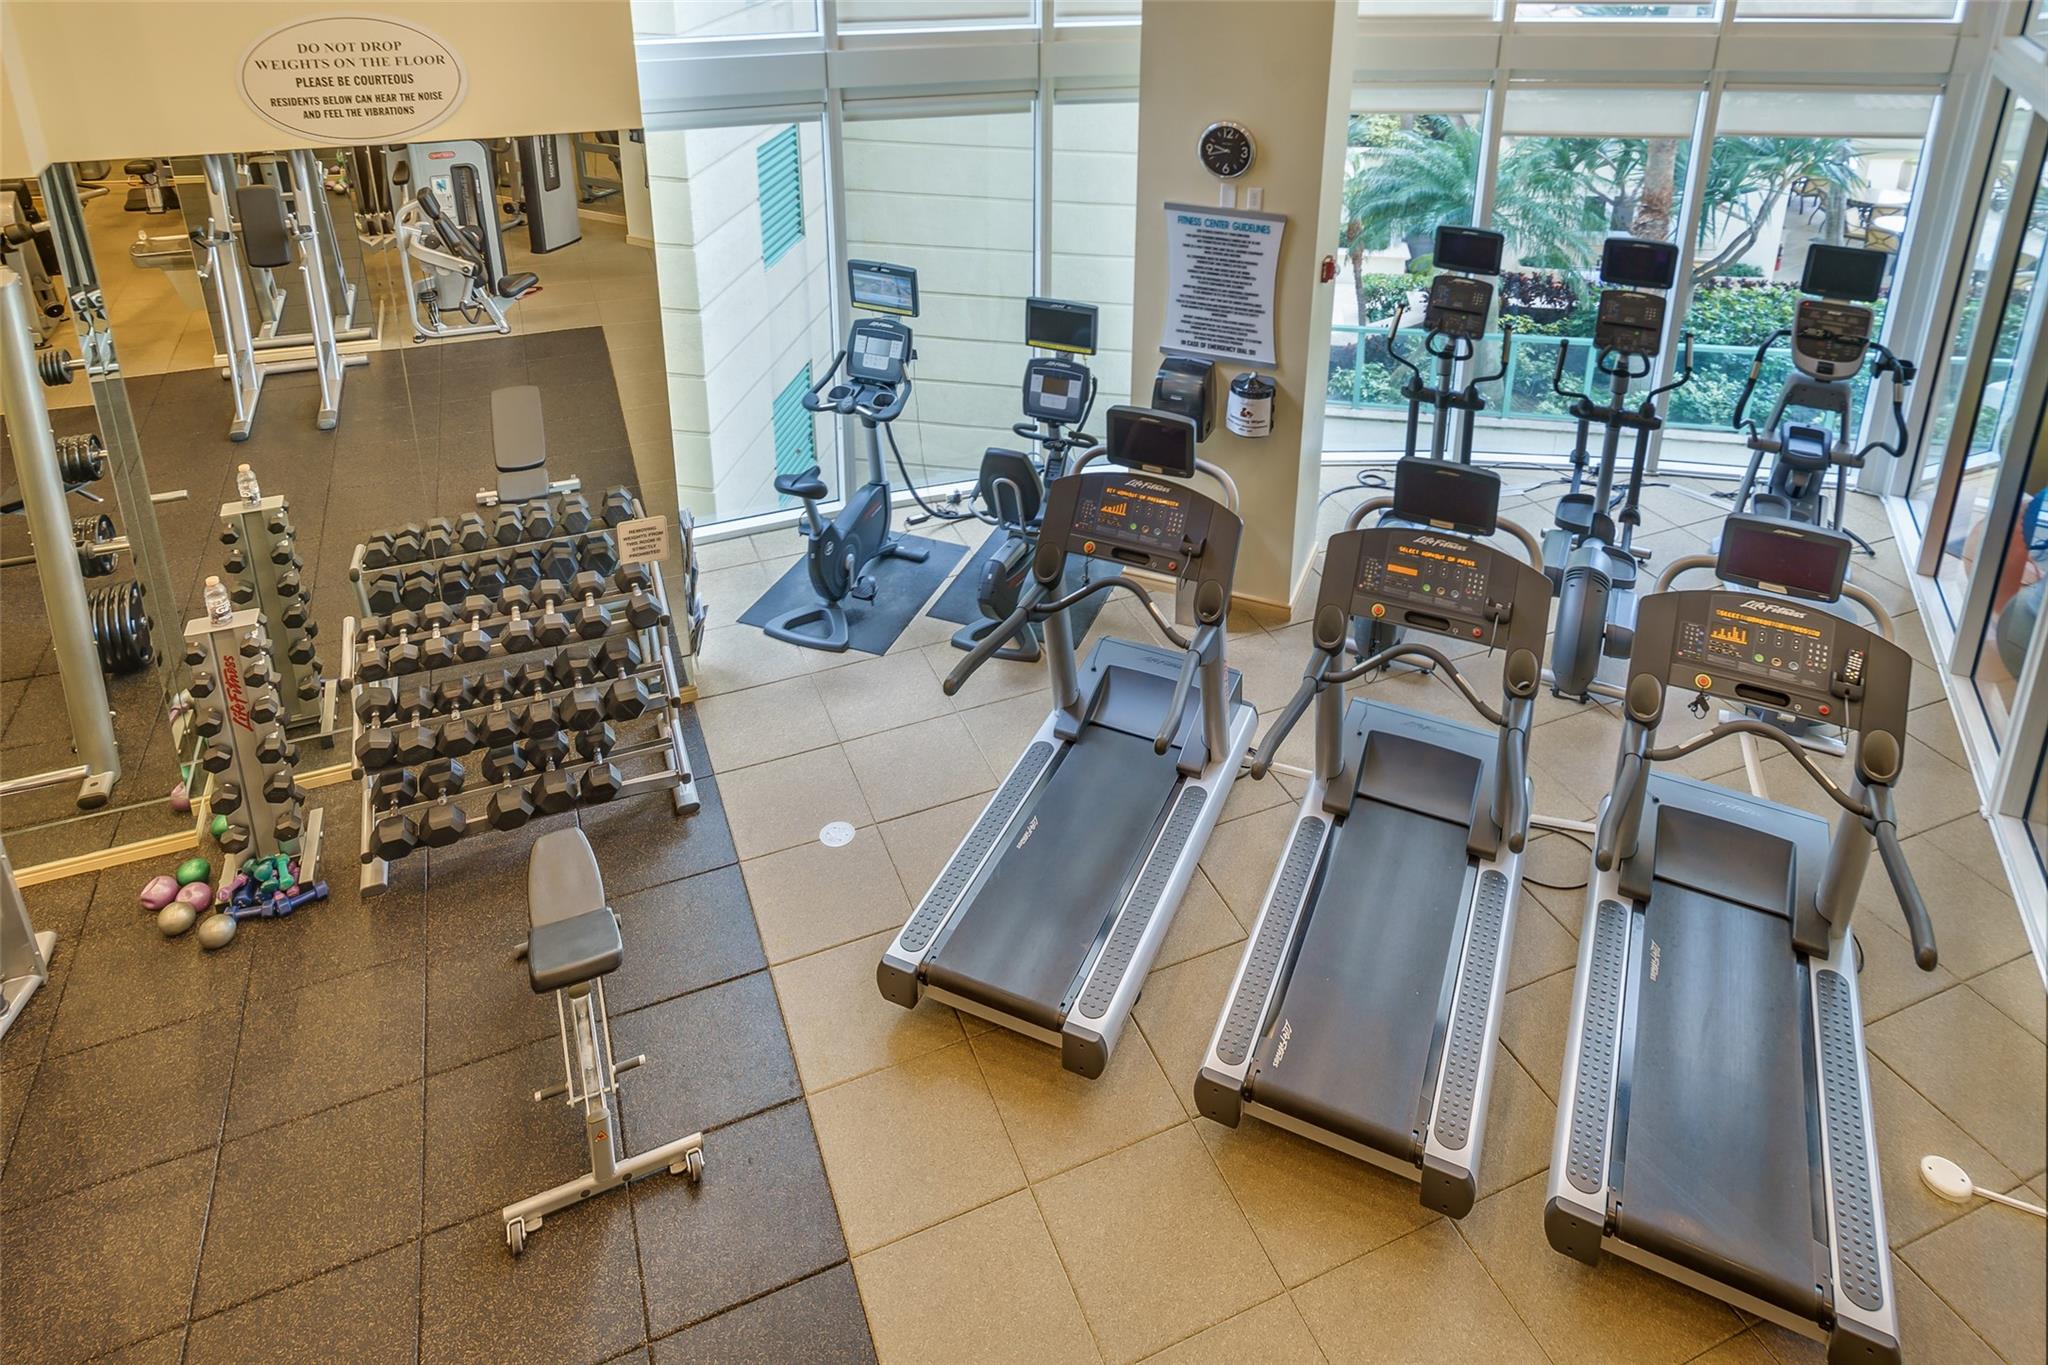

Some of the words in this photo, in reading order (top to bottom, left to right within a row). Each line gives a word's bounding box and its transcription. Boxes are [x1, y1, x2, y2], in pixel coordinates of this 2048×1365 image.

[297, 43, 320, 54] DO
[325, 42, 356, 53] NOT
[361, 41, 402, 52] DROP
[255, 58, 330, 71] WEIGHTS
[334, 58, 356, 69] ON
[360, 57, 390, 68] THE
[395, 55, 446, 67] FLOOR
[296, 76, 335, 88] PLEASE
[337, 76, 351, 87] BE
[354, 73, 414, 86] COURTEOUS
[270, 96, 320, 107] RESIDENTS
[322, 95, 352, 106] BELOW
[355, 94, 373, 104] CAN
[375, 93, 397, 103] HEAR
[400, 92, 416, 102] THE
[418, 91, 443, 101] NOISE
[303, 110, 321, 120] AND
[324, 109, 344, 119] FEEL
[346, 108, 362, 118] THE
[365, 106, 415, 117] VIBRATIONS
[1223, 127, 1234, 139] 12
[1206, 143, 1213, 155] 9
[1241, 147, 1249, 159] 3
[1222, 163, 1230, 174] 6
[1177, 215, 1202, 226] FITNESS
[1204, 218, 1230, 230] CENTER
[1232, 222, 1271, 235] GUIDELINES
[1207, 343, 1236, 353] EMERGENCY
[629, 525, 657, 534] REMOVING
[623, 532, 647, 541] WEIGHTS
[628, 549, 661, 558] PROHIBITED
[632, 544, 657, 552] STRICTLY
[1399, 546, 1419, 555] SELECT
[1421, 550, 1445, 561] WORKOUT
[1457, 558, 1476, 567] PRESS
